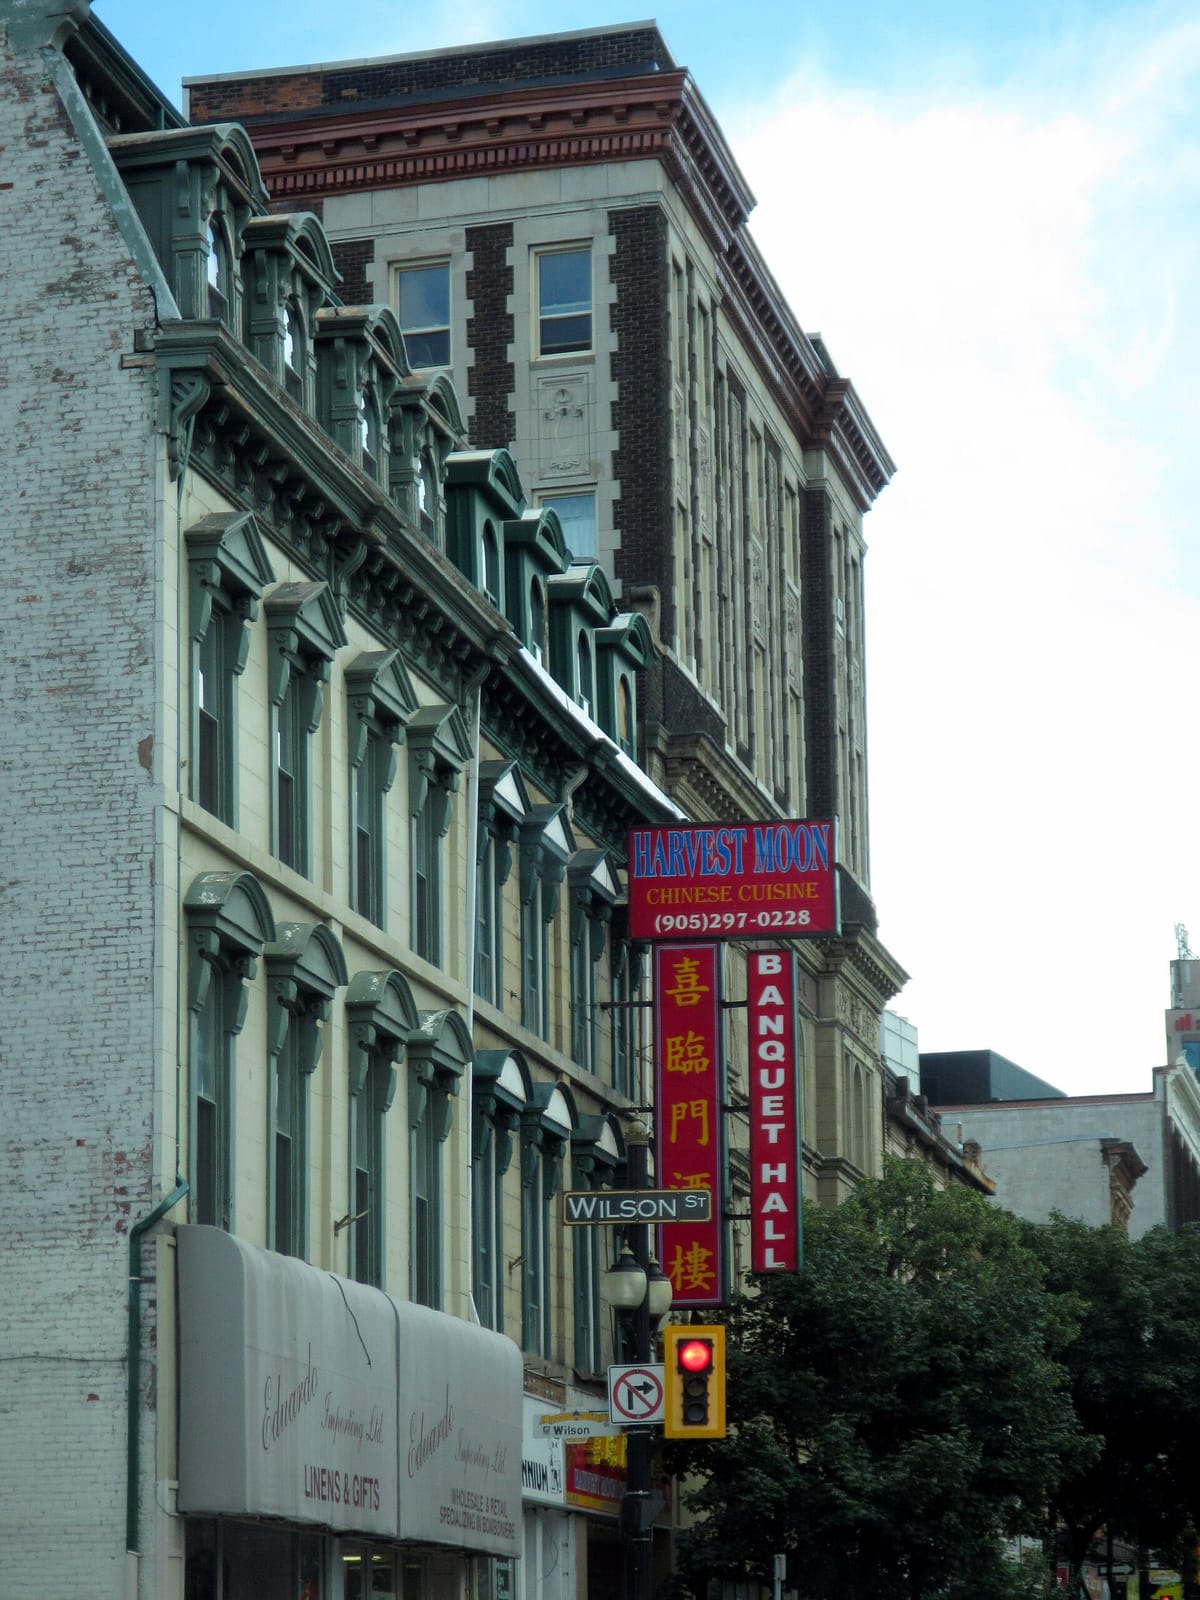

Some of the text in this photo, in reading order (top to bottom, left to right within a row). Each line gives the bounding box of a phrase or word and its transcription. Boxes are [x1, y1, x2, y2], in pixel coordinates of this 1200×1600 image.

[634, 824, 830, 878] HARVEST MOON
[646, 882, 819, 904] CHINESE CUISINE
[654, 910, 811, 933] (905)297-0228
[757, 955, 788, 1268] BANQUET HALL
[568, 1197, 677, 1219] WILSON
[262, 1342, 318, 1450] Eduardo
[407, 1384, 454, 1479] Eduardo
[553, 1426, 590, 1435] Wilson
[304, 1464, 380, 1511] LINENS & GIFTS
